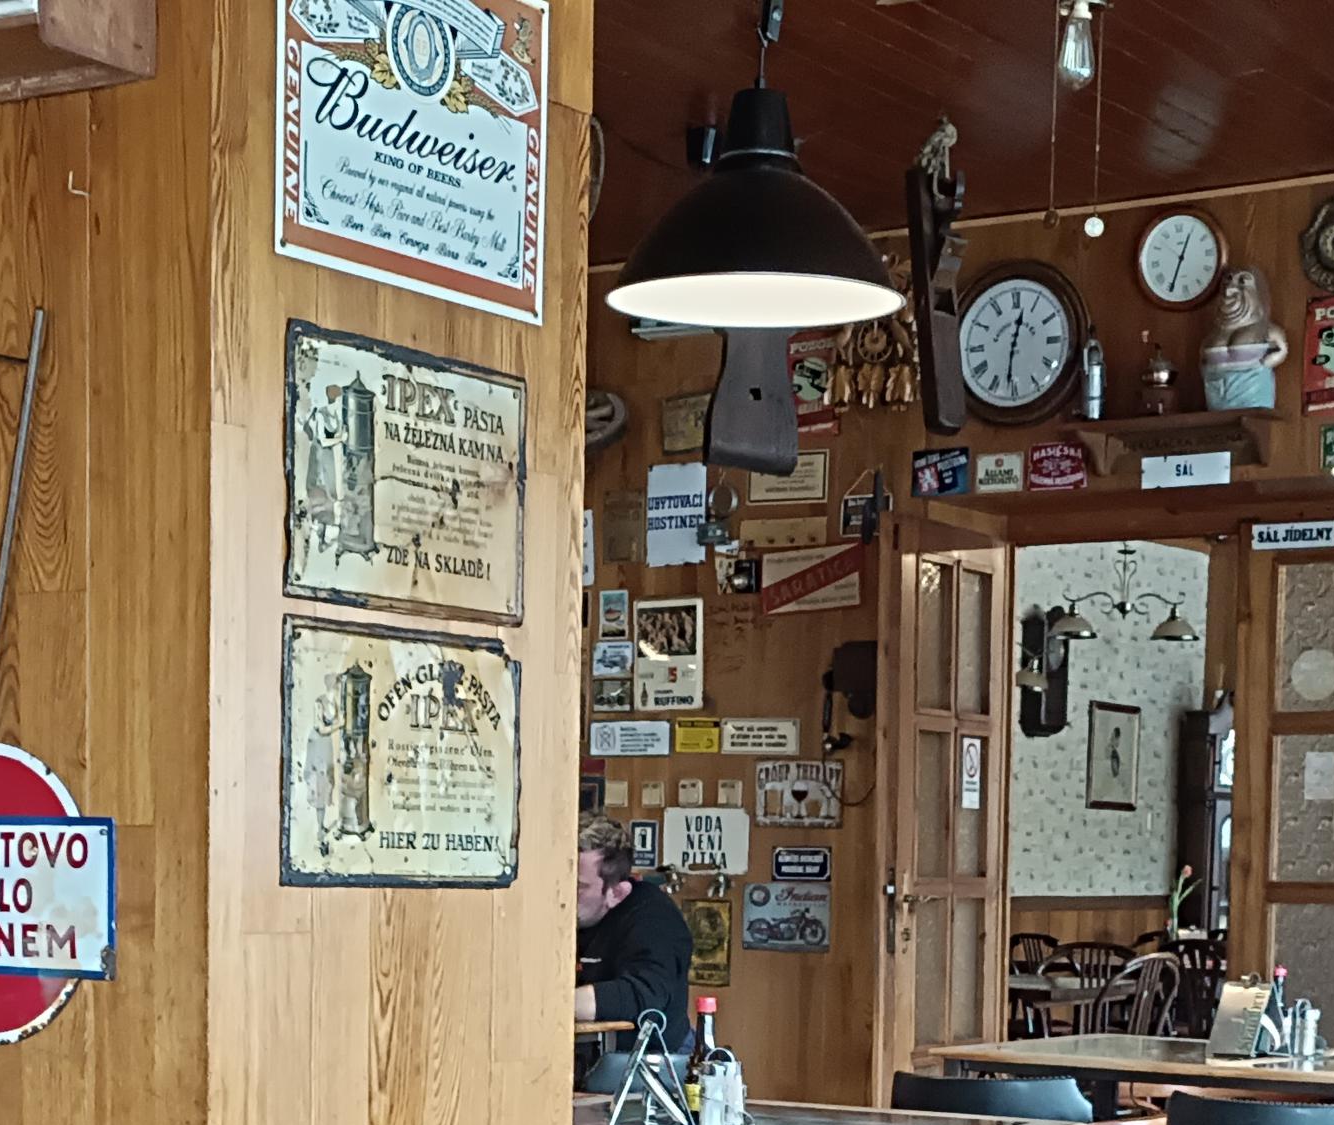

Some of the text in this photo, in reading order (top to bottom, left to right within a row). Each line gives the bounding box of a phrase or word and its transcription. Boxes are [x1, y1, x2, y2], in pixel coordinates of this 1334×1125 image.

[306, 56, 516, 184] Budweiser
[374, 151, 462, 188] KING OF BEERS
[523, 129, 539, 293] GENUINE
[384, 421, 401, 444] NA
[1175, 460, 1194, 477] SÁL
[1257, 525, 1333, 543] SÁL JÍDELNY
[386, 546, 409, 567] ZDE
[415, 549, 431, 571] NA
[685, 815, 723, 833] VODA
[379, 831, 417, 850] HIER
[422, 832, 441, 850] ZU
